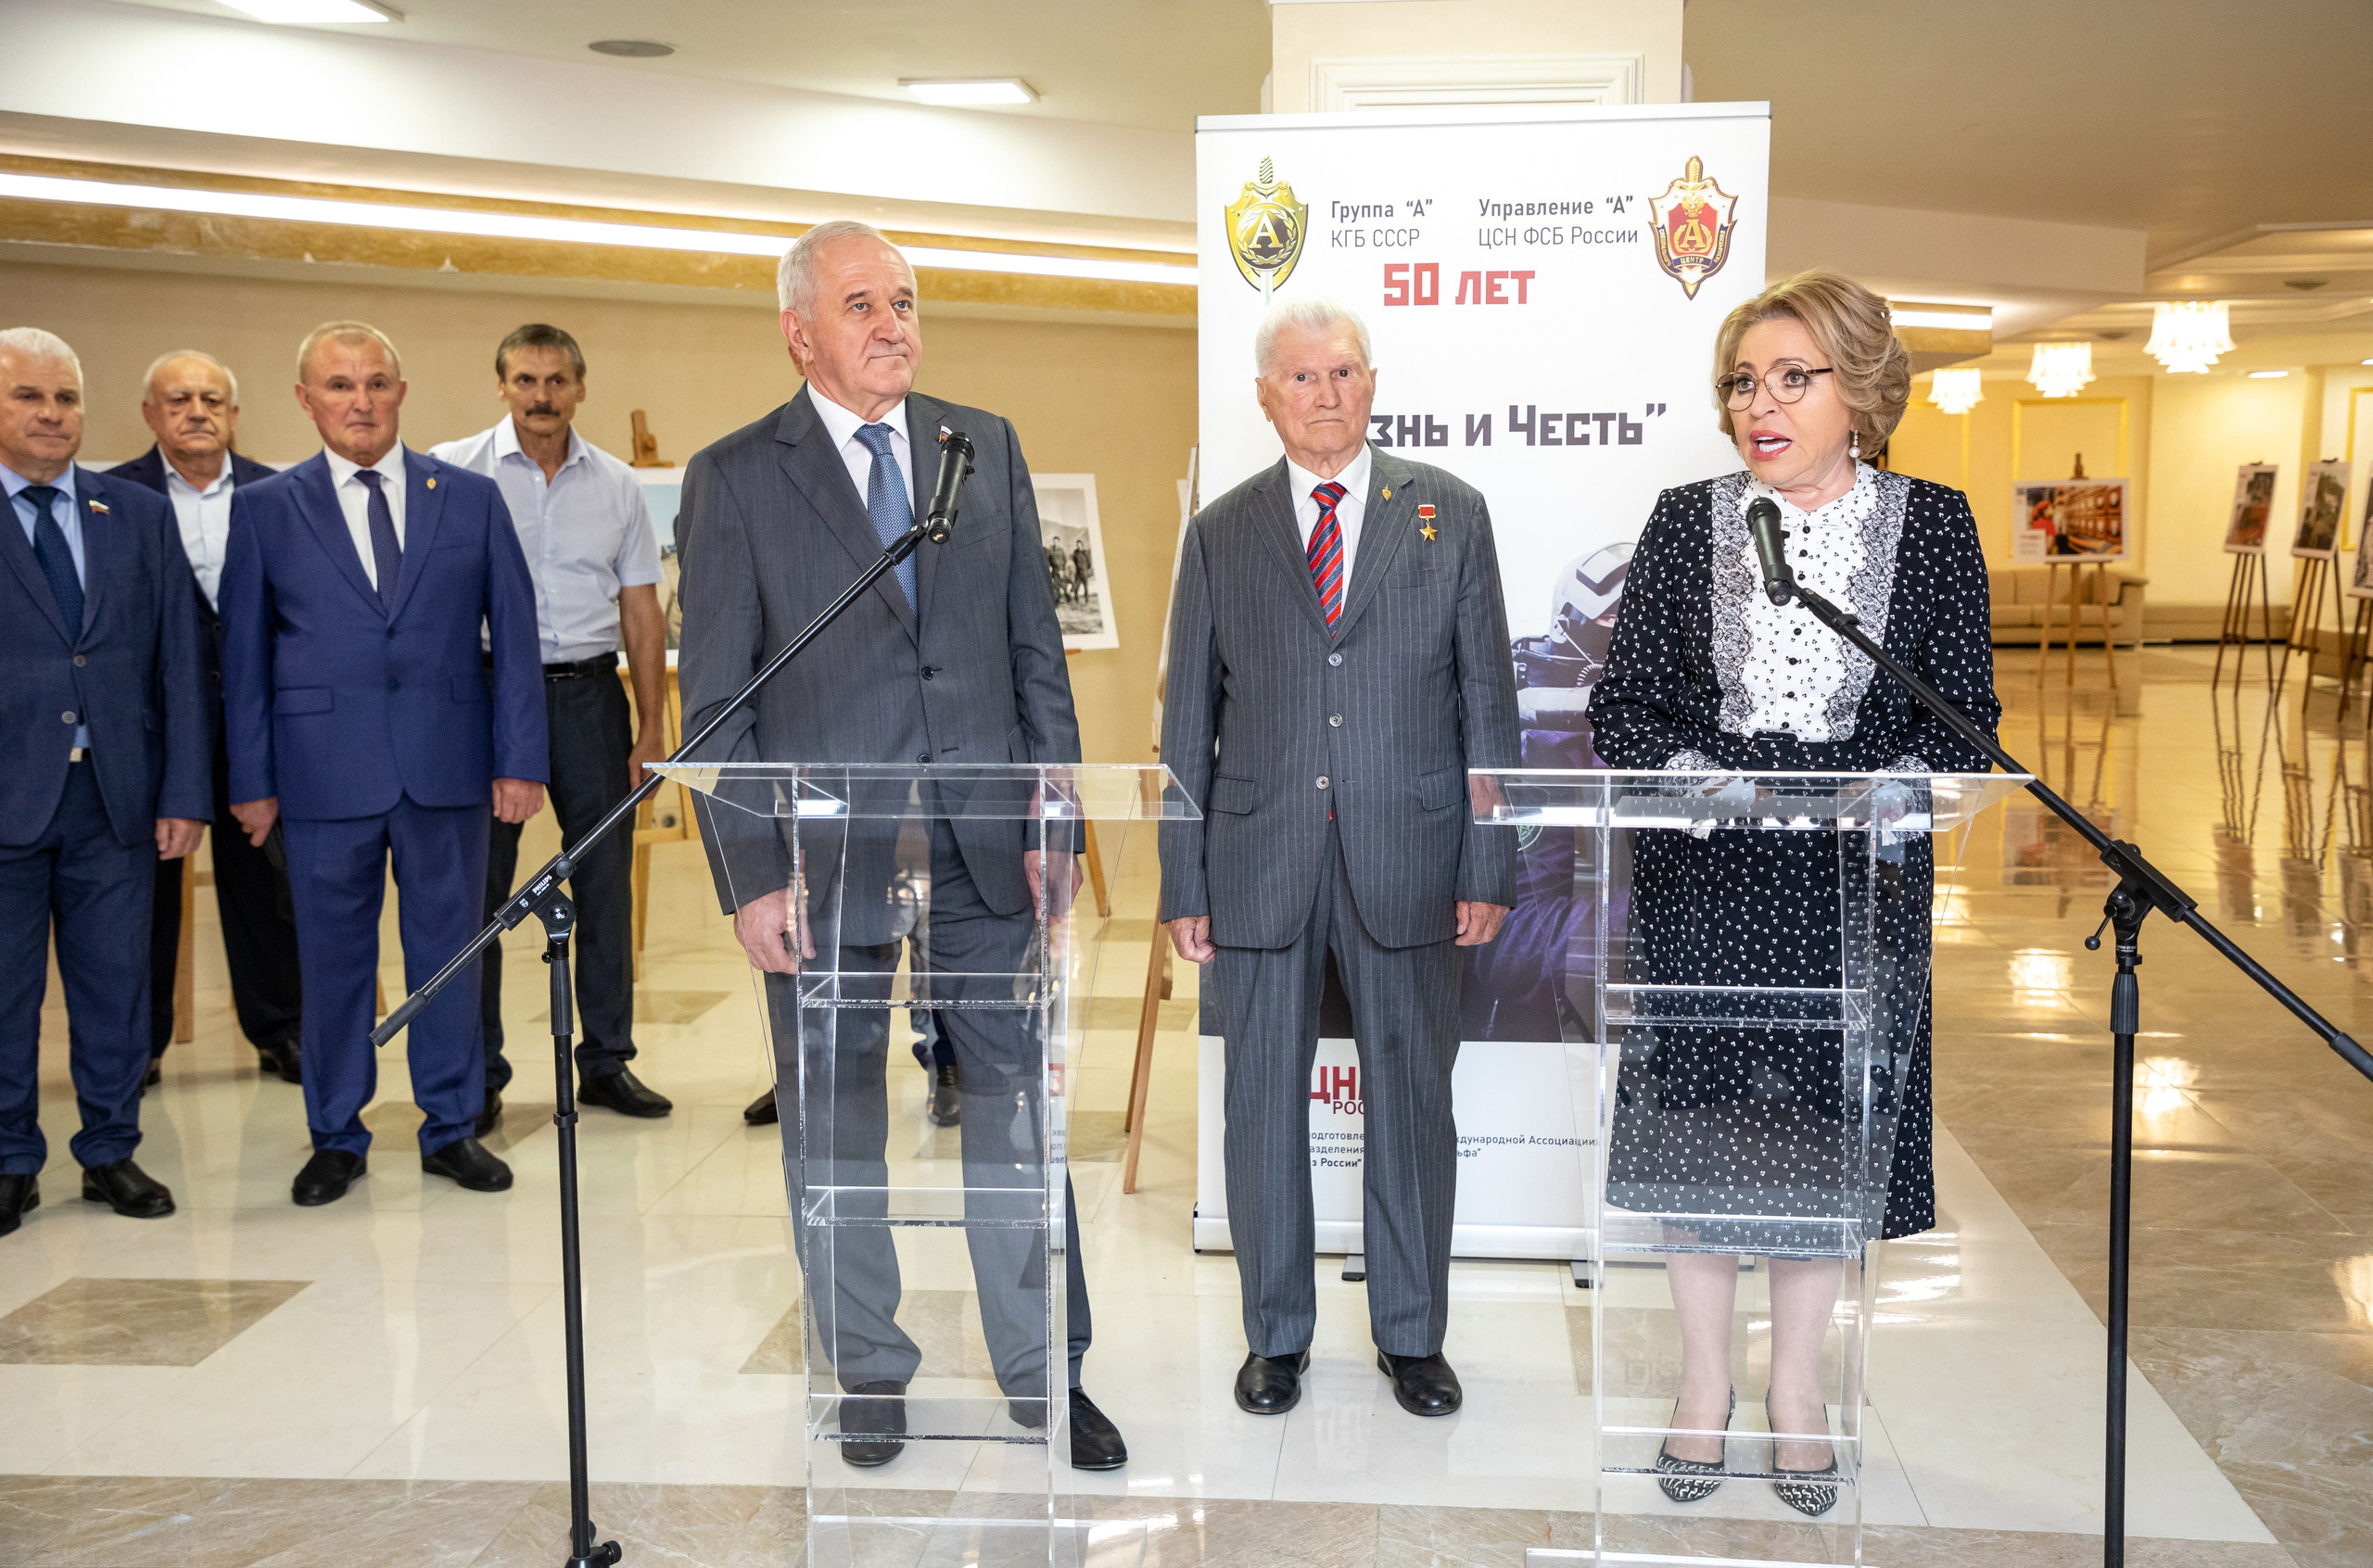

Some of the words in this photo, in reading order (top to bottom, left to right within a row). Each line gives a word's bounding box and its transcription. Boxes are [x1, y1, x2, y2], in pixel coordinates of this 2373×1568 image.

[1331, 200, 1394, 223] Группа
[1478, 198, 1594, 221] Управление
[1331, 229, 1365, 247] КГБ
[1373, 228, 1420, 247] СССР
[1478, 227, 1516, 249] ЦСН
[1524, 226, 1564, 246] ФСБ
[1571, 225, 1638, 245] России
[1680, 256, 1705, 265] ЦЕНТР
[1384, 262, 1440, 307] 50
[531, 874, 552, 894] PHILIPS
[1310, 1066, 1362, 1105] ЦН
[1332, 1100, 1364, 1115] РОС
[1310, 1132, 1364, 1141] одготовле
[1456, 1134, 1526, 1145] дународной
[1310, 1145, 1364, 1155] азделения
